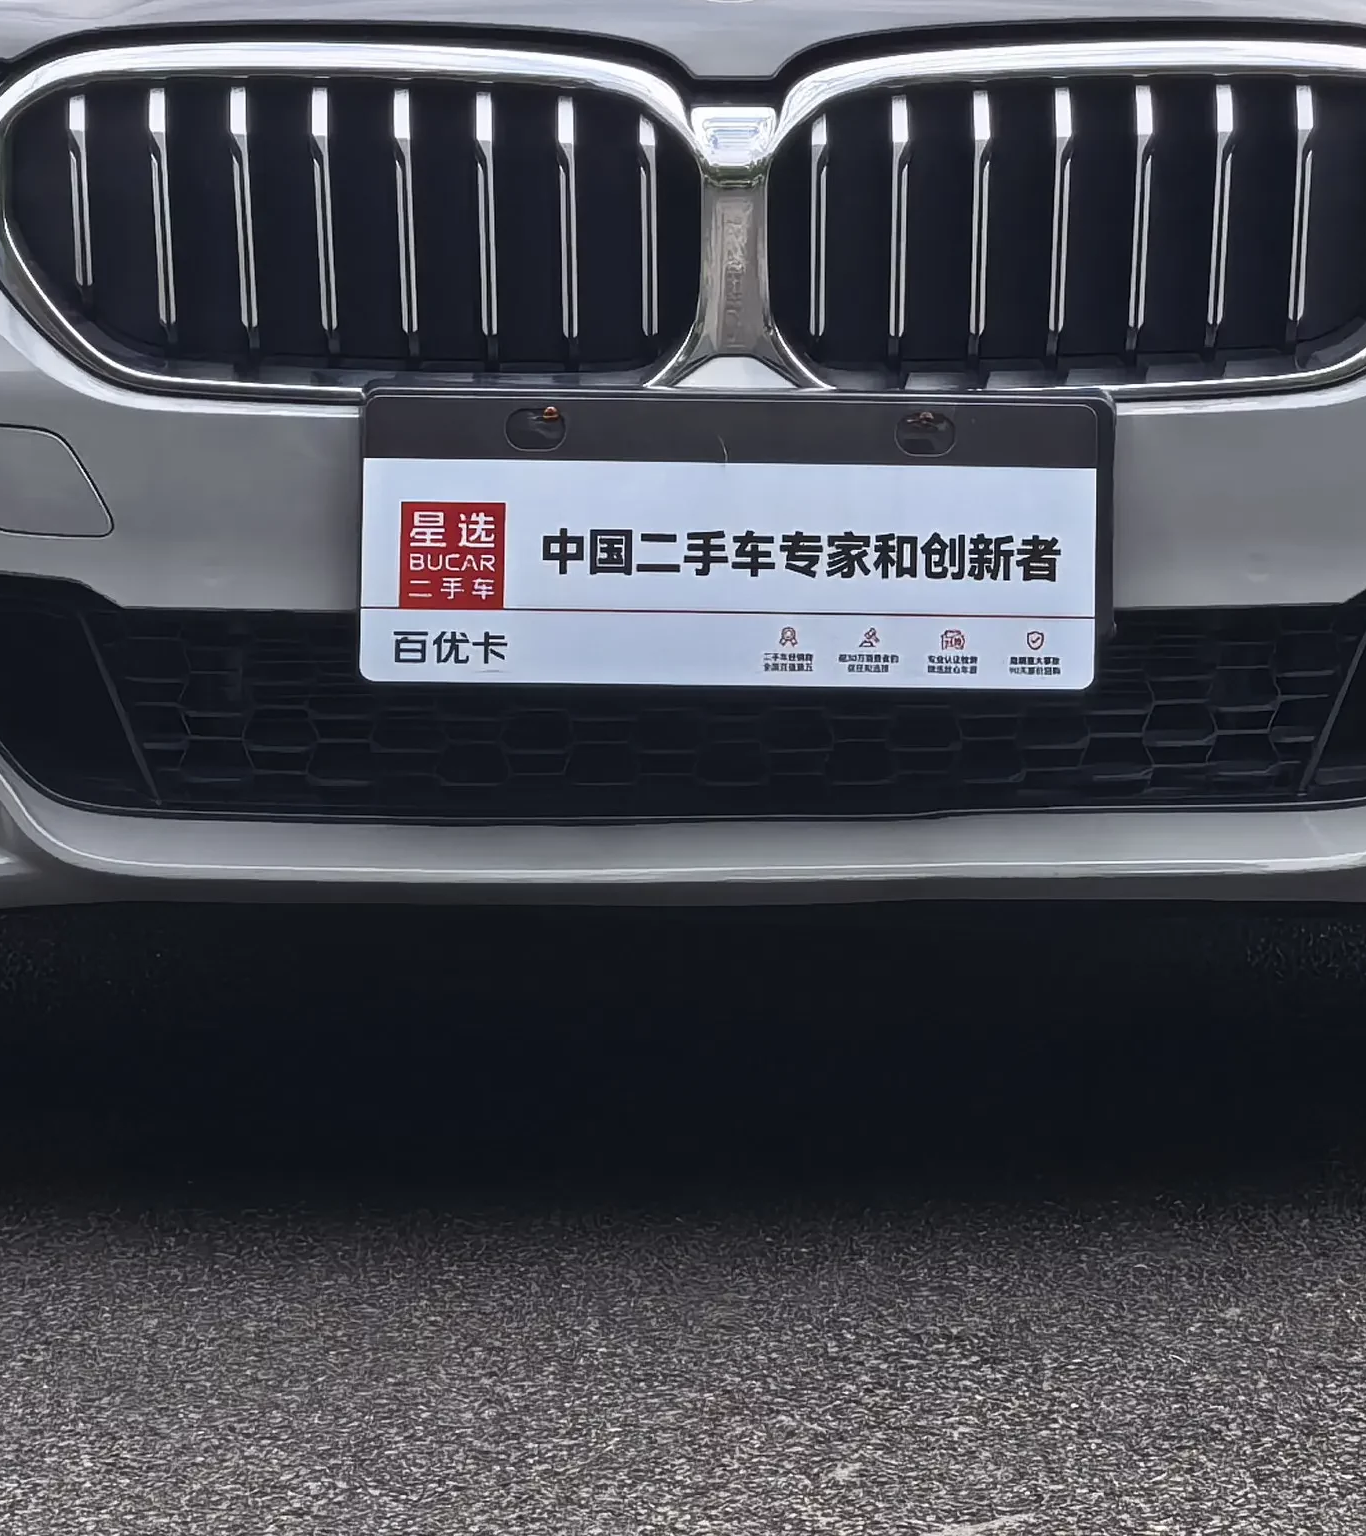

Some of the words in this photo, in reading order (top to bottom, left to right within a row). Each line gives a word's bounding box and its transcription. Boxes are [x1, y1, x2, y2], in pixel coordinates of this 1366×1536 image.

[410, 512, 494, 547] 星选
[410, 553, 495, 571] BUCAR
[542, 528, 1062, 582] 中国二手车专家和创新者
[409, 577, 494, 599] 二手车
[393, 630, 508, 664] 百优卡
